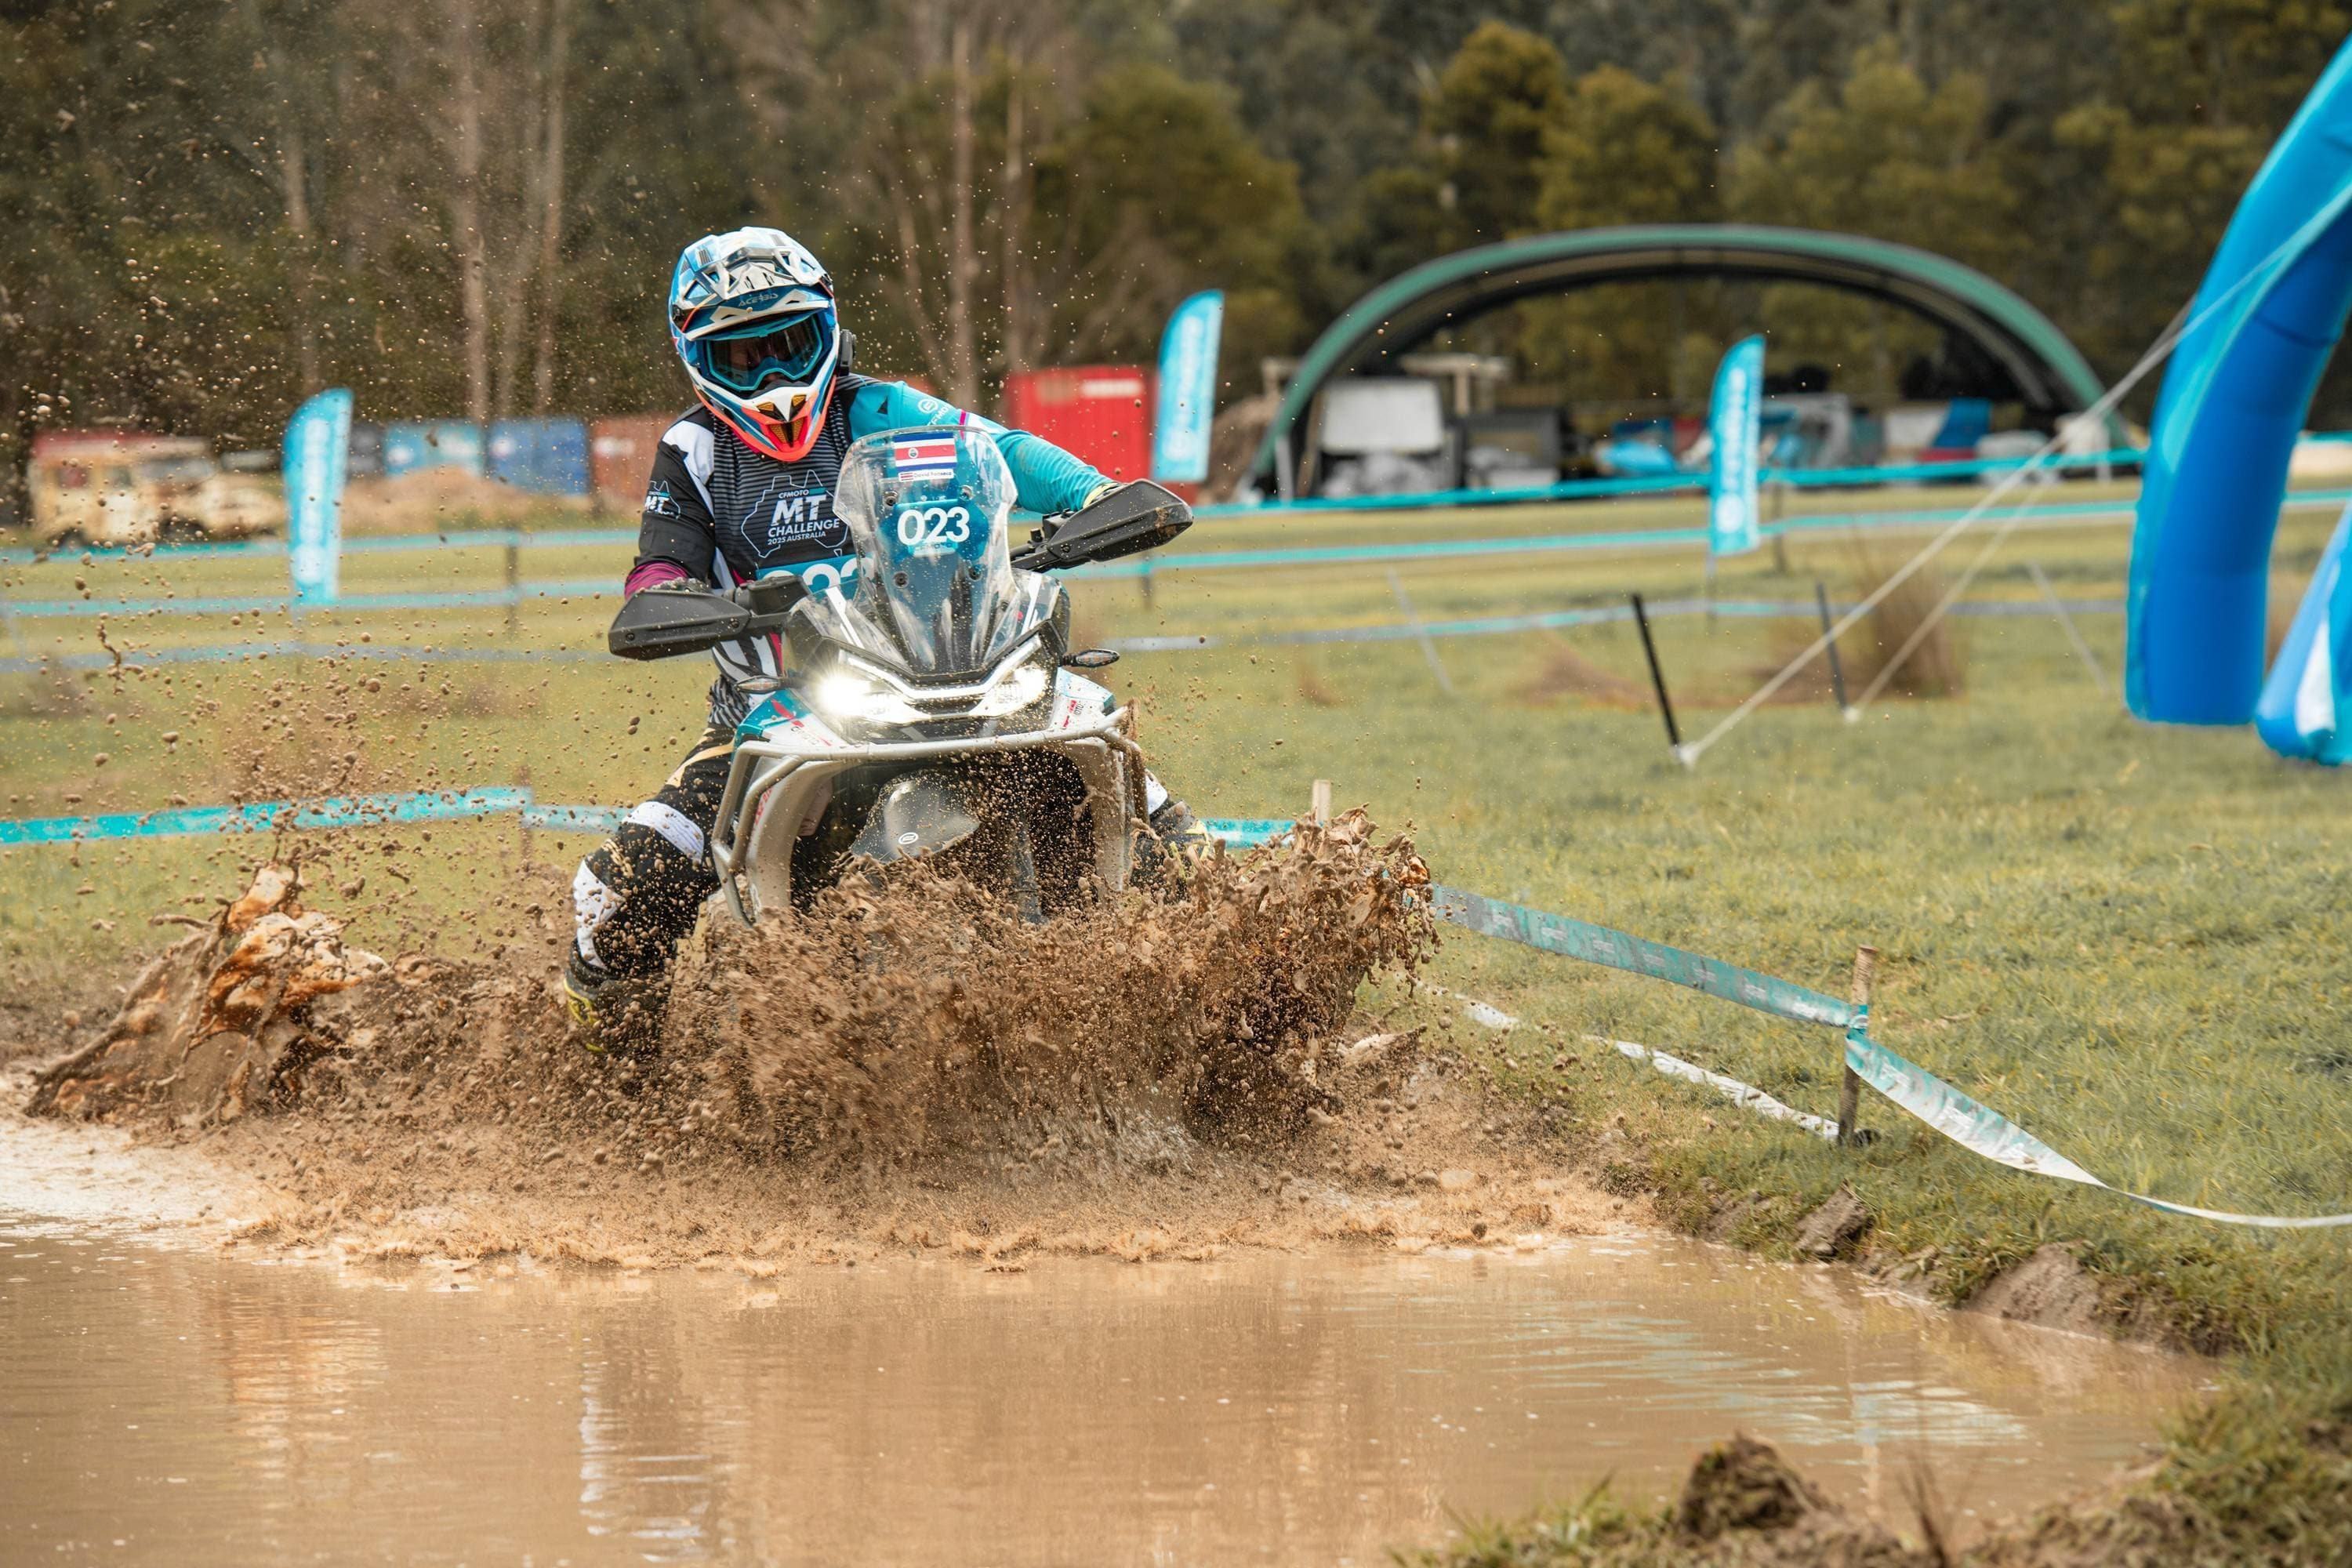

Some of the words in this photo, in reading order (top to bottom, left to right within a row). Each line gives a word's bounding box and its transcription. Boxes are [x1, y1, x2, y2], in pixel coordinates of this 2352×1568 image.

[778, 489, 809, 499] CFMOTO
[771, 495, 827, 526] MT
[768, 519, 840, 537] CHALLENGE
[897, 506, 970, 545] 023
[768, 535, 786, 545] 2025
[787, 531, 826, 542] AUSTRALIA
